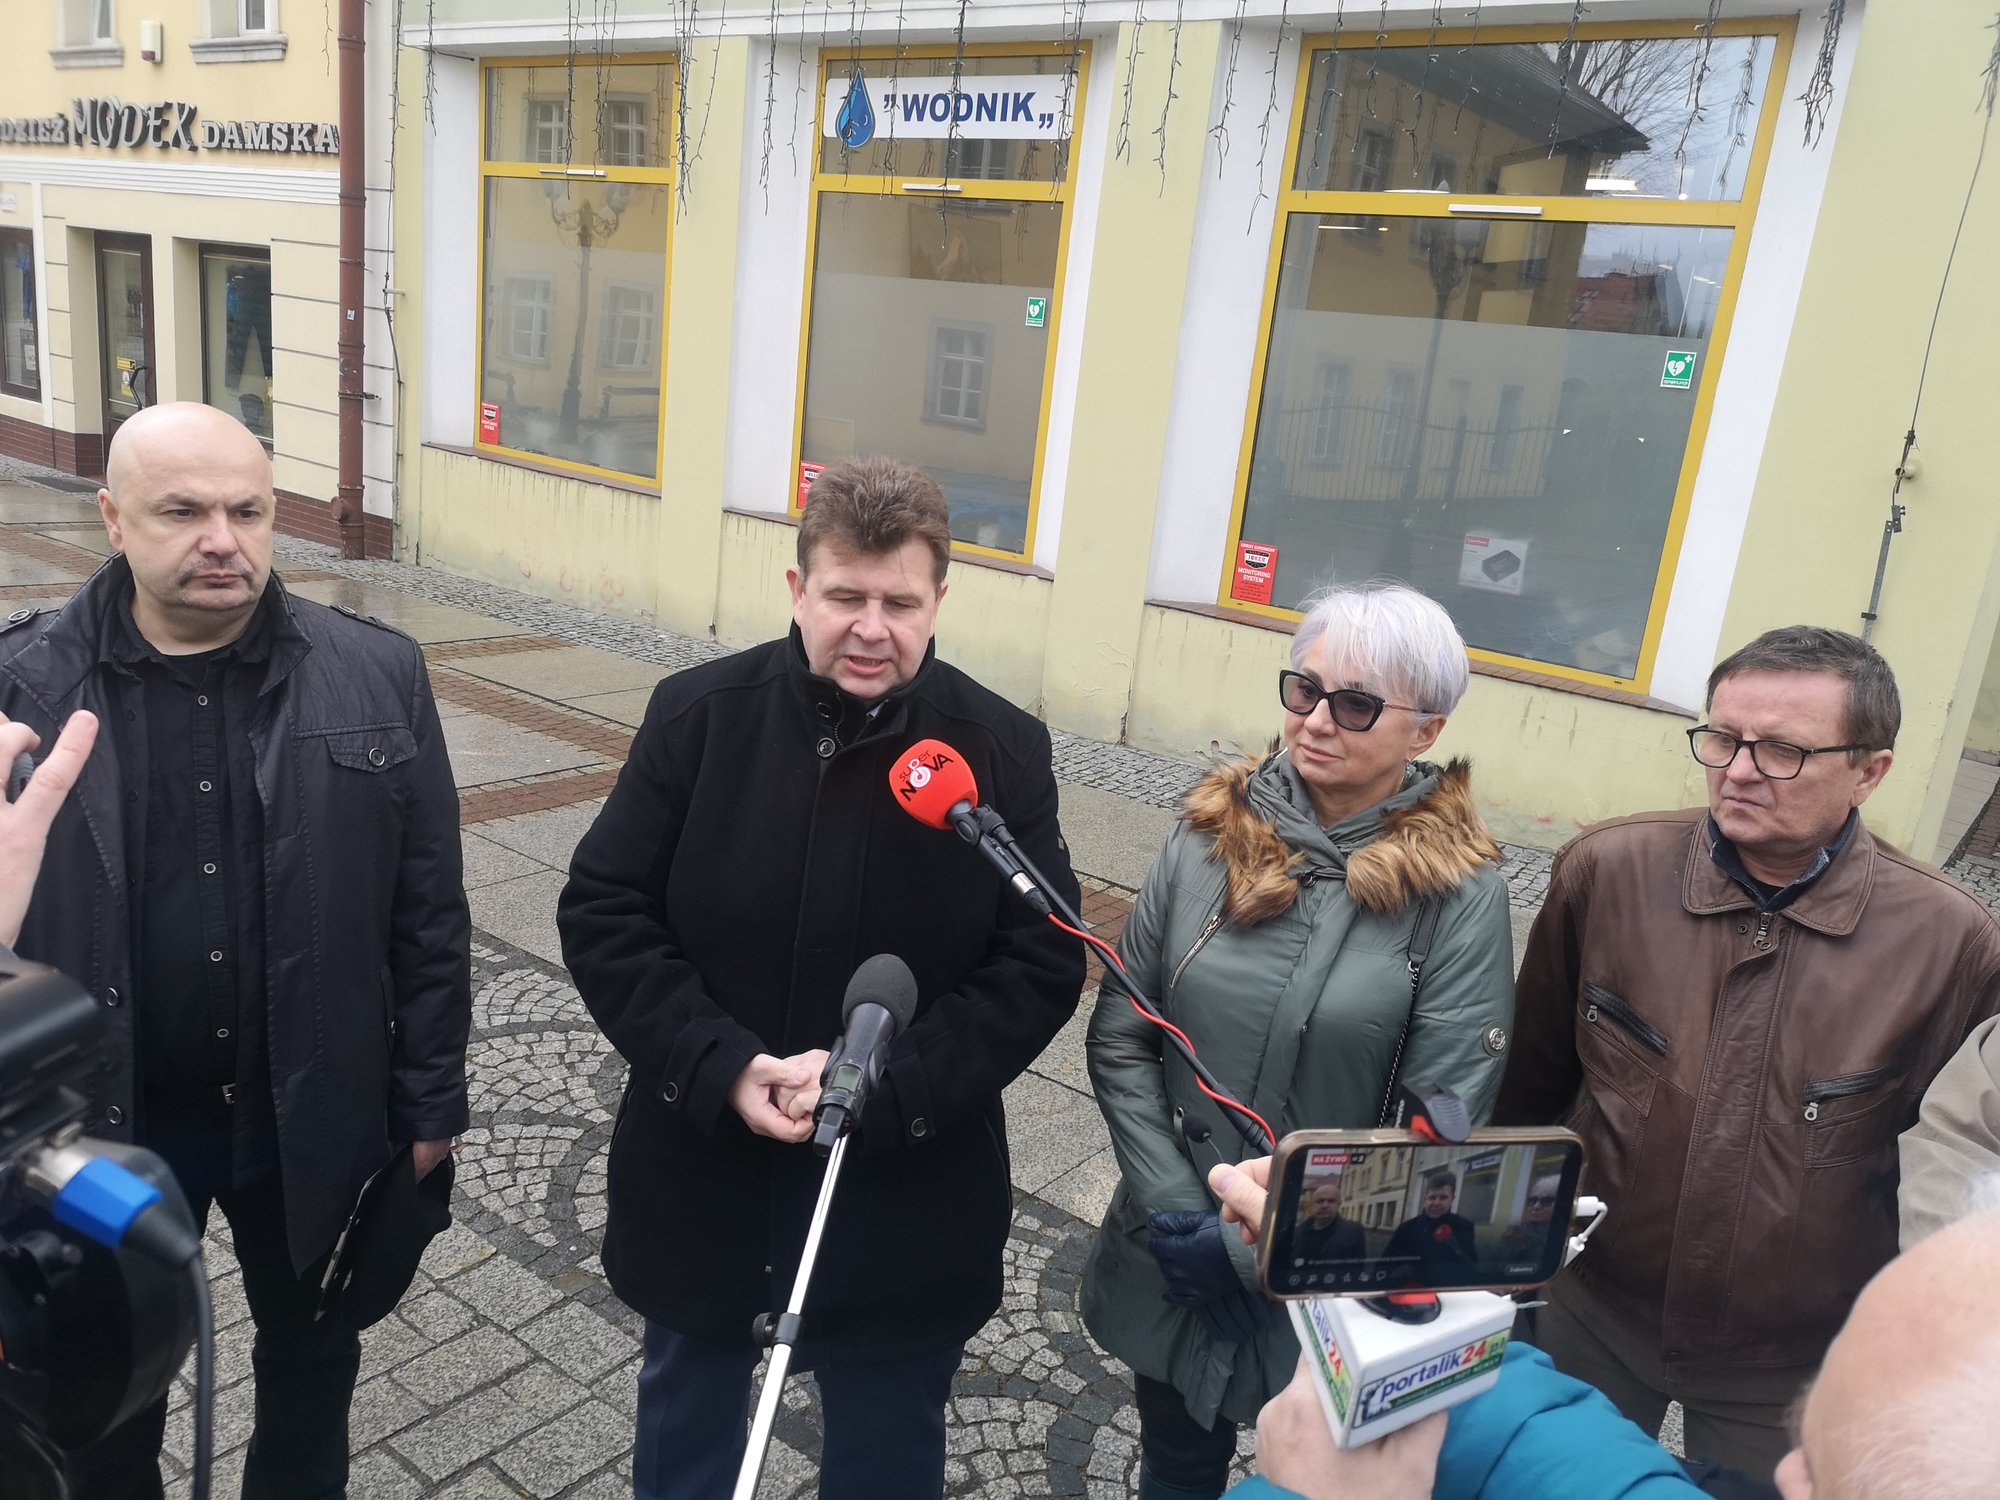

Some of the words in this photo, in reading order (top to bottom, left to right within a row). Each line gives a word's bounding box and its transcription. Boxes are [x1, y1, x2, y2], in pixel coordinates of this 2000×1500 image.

[72, 96, 198, 152] MODEX
[201, 120, 339, 154] DAMSKA
[1238, 567, 1271, 578] MONITORING
[1243, 574, 1264, 583] SYSTEM
[900, 753, 954, 802] NOVA
